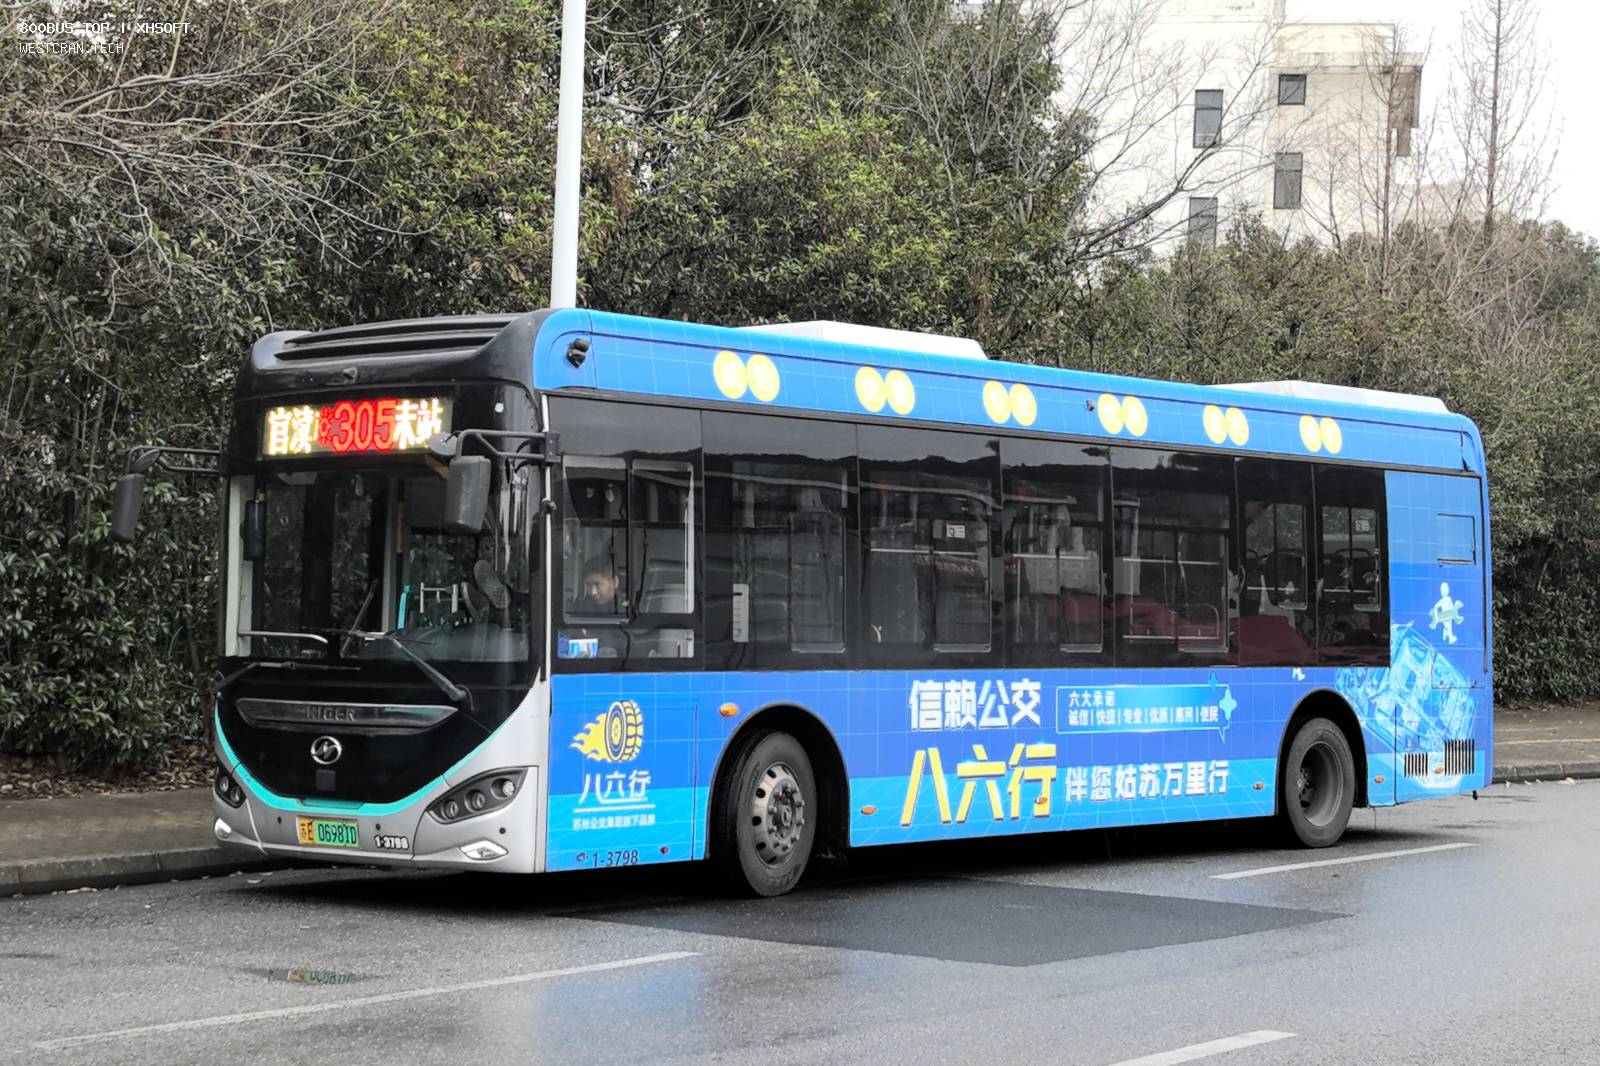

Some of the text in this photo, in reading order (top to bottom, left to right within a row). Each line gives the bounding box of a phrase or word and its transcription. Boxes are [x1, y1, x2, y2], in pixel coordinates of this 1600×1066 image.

[332, 399, 397, 453] 305
[909, 678, 1042, 732] 信赖公交
[578, 769, 652, 805] 八六行
[900, 742, 1057, 827] 八六行
[1064, 760, 1230, 804] 伴您姑苏万里行
[592, 848, 639, 868] 1-3798
